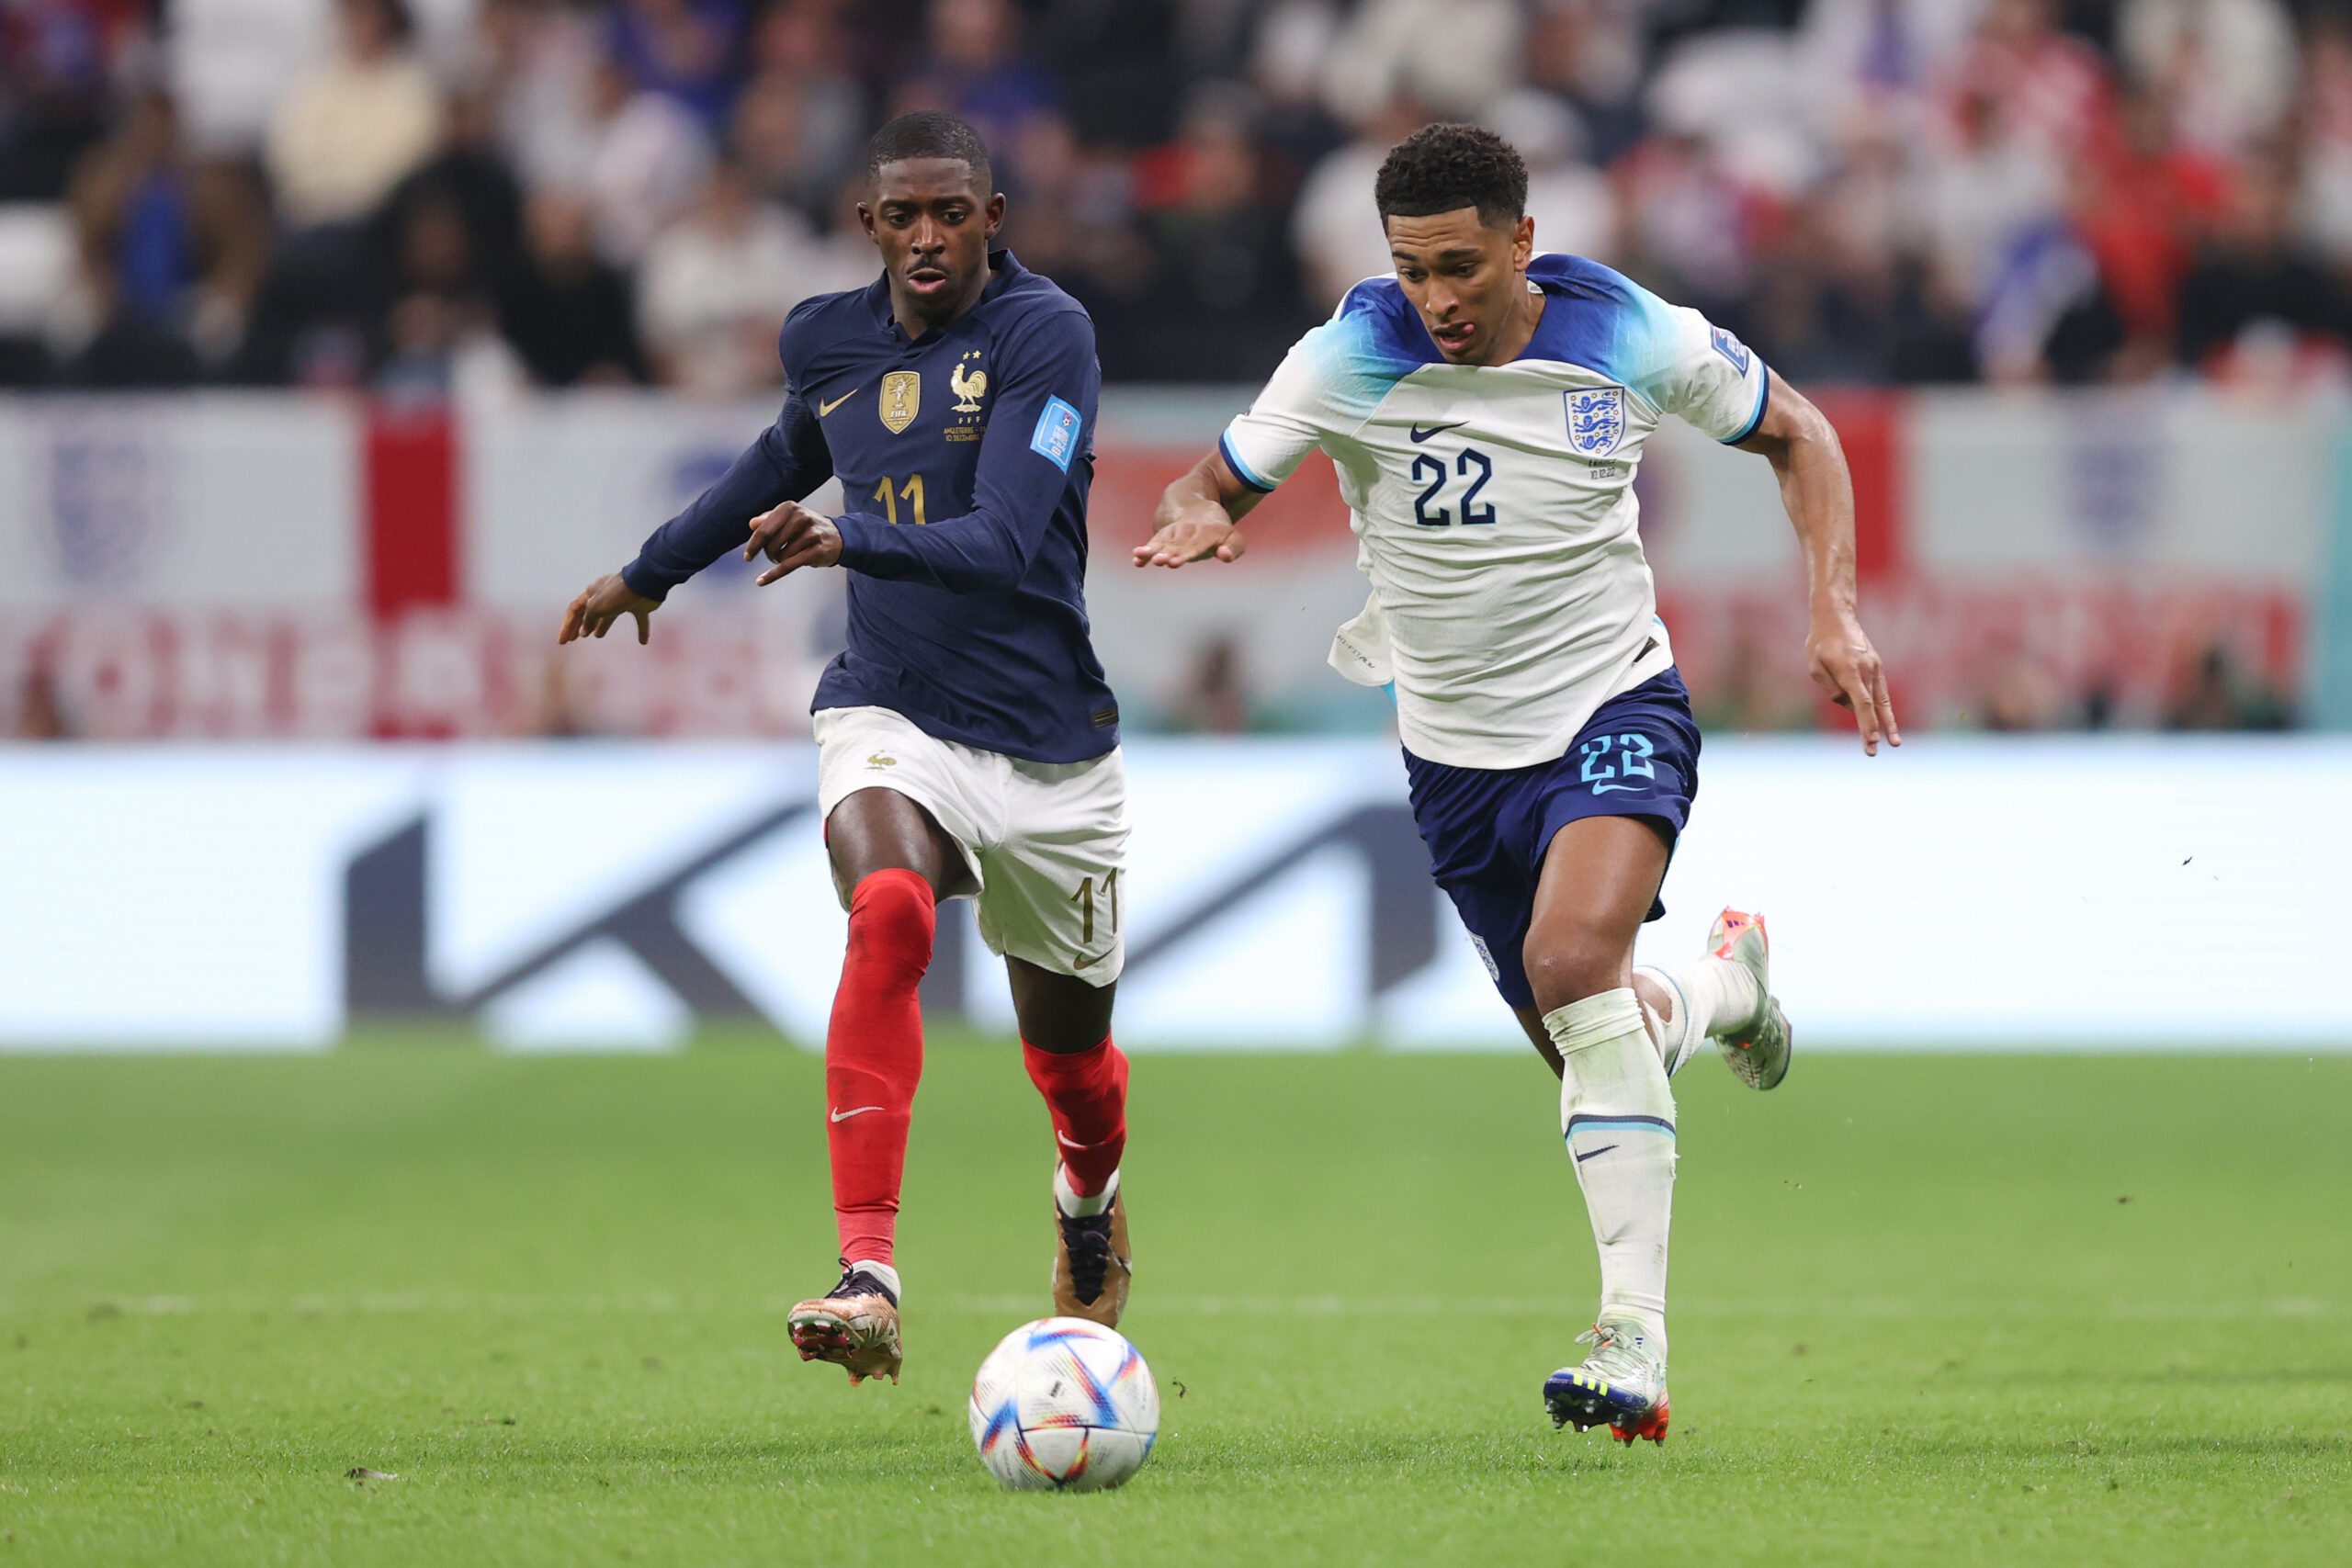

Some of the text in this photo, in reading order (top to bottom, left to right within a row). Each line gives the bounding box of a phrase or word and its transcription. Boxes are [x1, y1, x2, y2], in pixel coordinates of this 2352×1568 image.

[890, 410, 908, 418] FIFA
[874, 473, 926, 525] 11
[1411, 447, 1496, 526] 22
[1580, 733, 1656, 783] 22
[1069, 867, 1118, 945] 11
